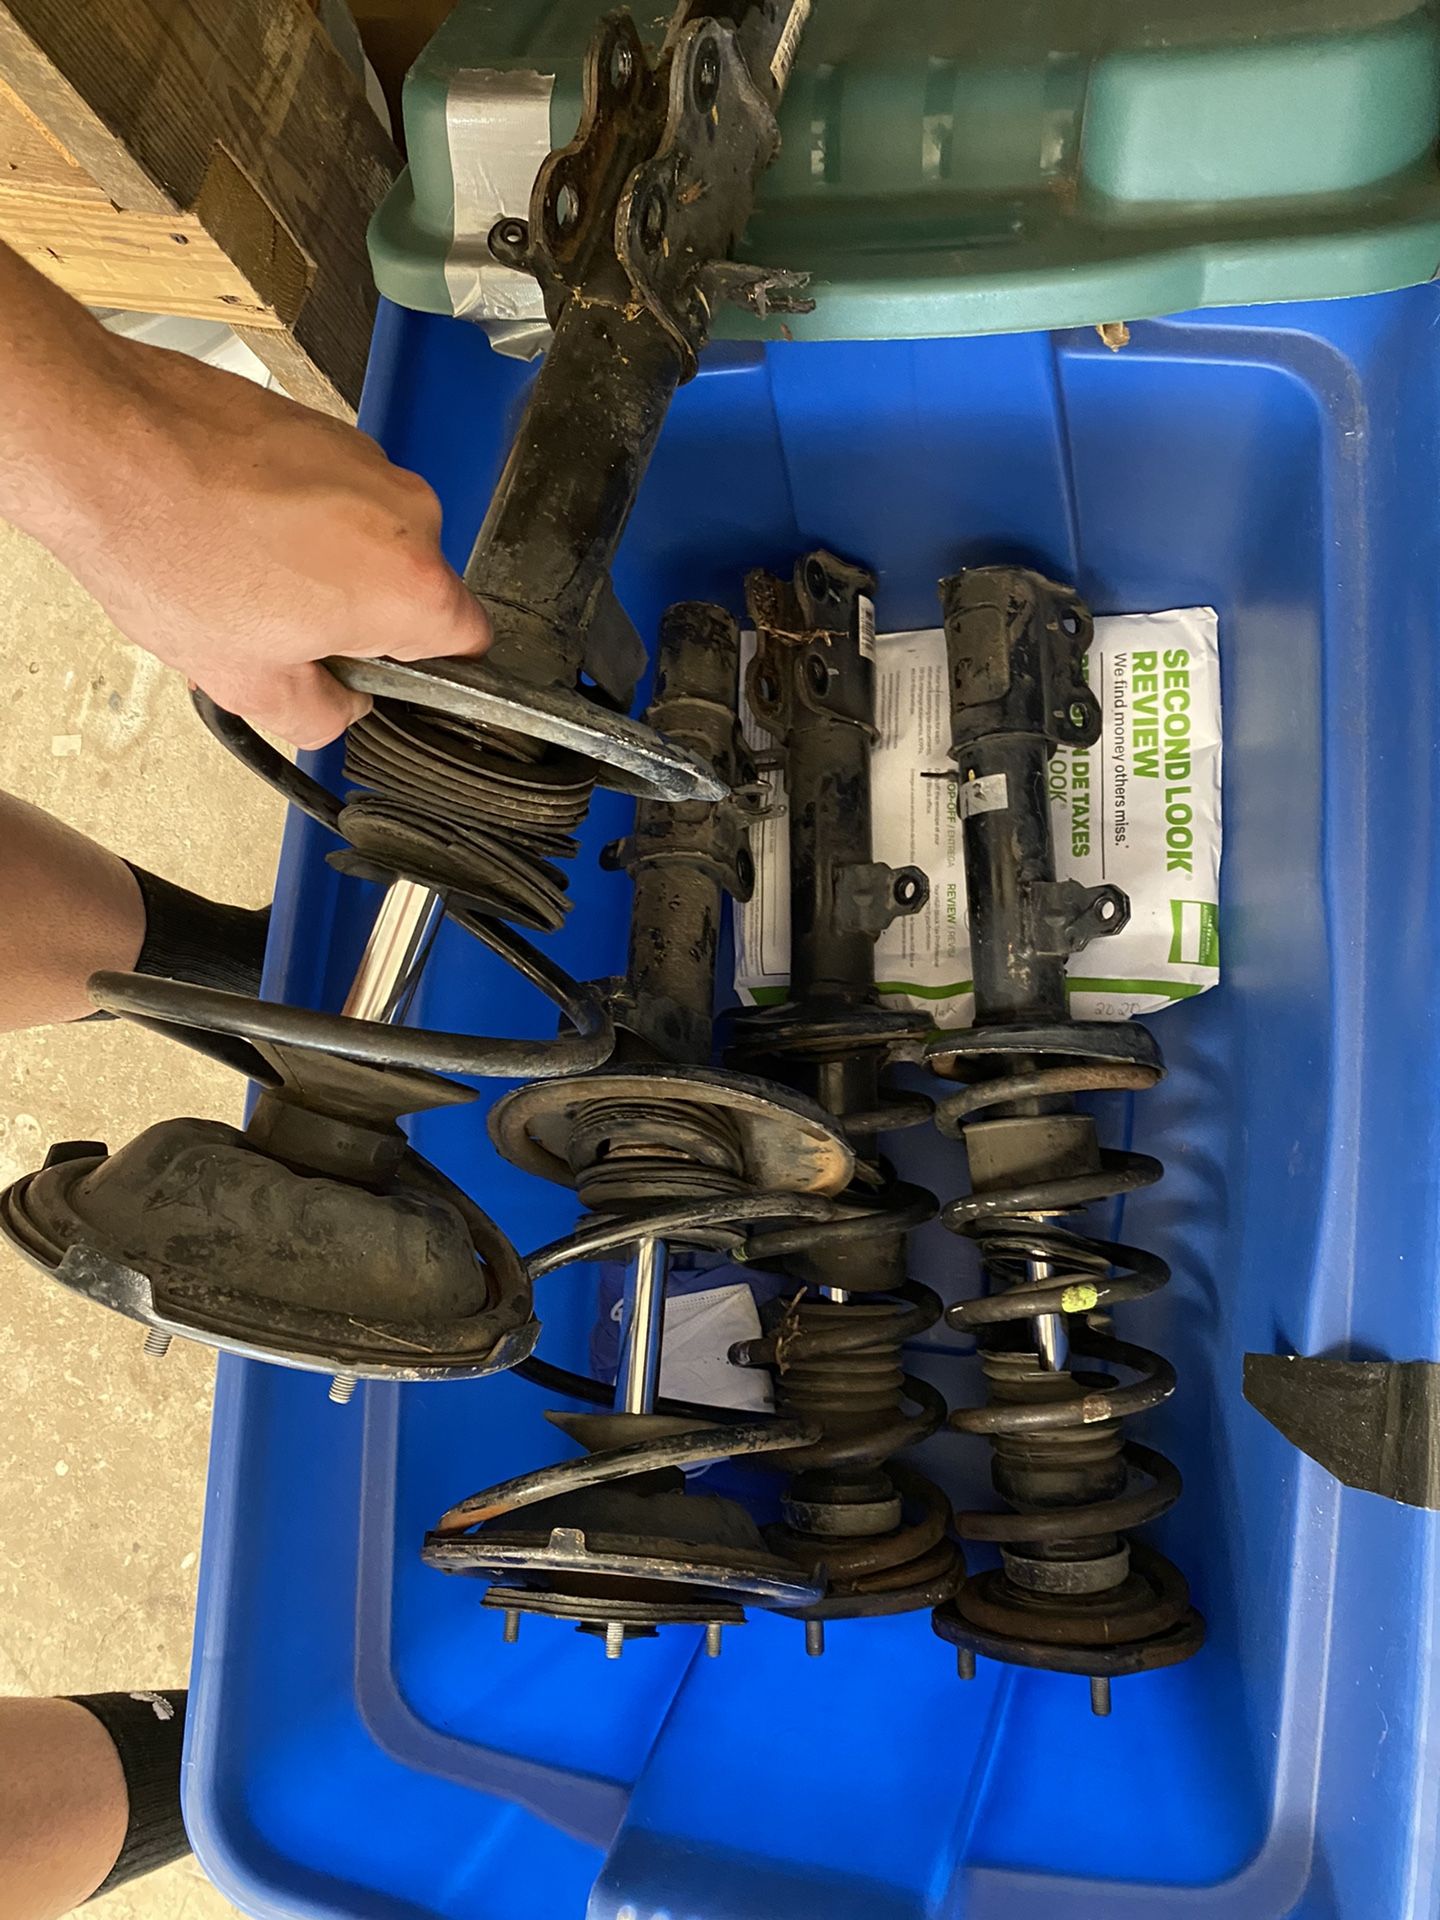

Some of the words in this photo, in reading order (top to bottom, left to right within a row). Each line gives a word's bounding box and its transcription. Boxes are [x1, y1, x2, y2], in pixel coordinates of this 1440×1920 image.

[1114, 653, 1127, 677] We
[1114, 680, 1128, 708] find
[1132, 650, 1160, 778] REVIEW
[1163, 649, 1192, 781] SECOND
[1111, 712, 1125, 761] money
[1072, 761, 1090, 790] DE
[1115, 764, 1128, 808] others
[1072, 793, 1090, 858] TAXES
[946, 883, 957, 924] REVIEW
